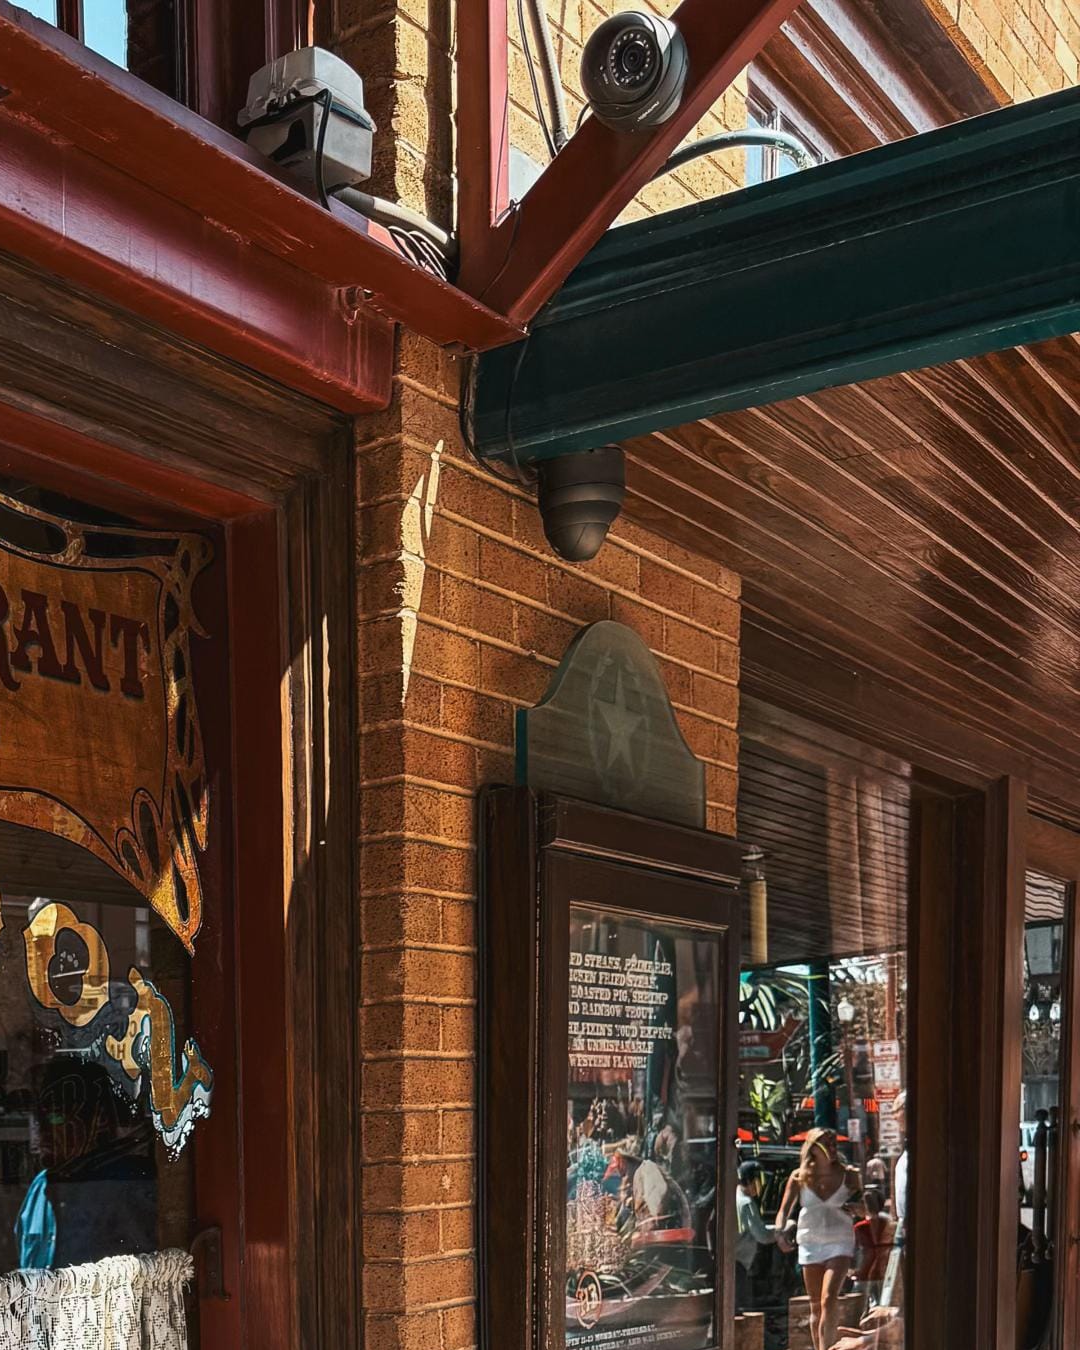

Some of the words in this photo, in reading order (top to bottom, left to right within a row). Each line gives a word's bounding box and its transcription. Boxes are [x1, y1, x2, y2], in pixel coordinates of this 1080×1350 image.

[599, 971, 626, 986] FRIED
[571, 985, 611, 1001] ROASTED
[632, 991, 668, 1005] SHRIMP
[581, 1002, 623, 1017] RAINBOW
[625, 1005, 657, 1020] TROUT.
[639, 1026, 672, 1040] EXPECT
[587, 1038, 655, 1054] UNMISTAKABLE
[568, 1054, 611, 1068] WESTERN
